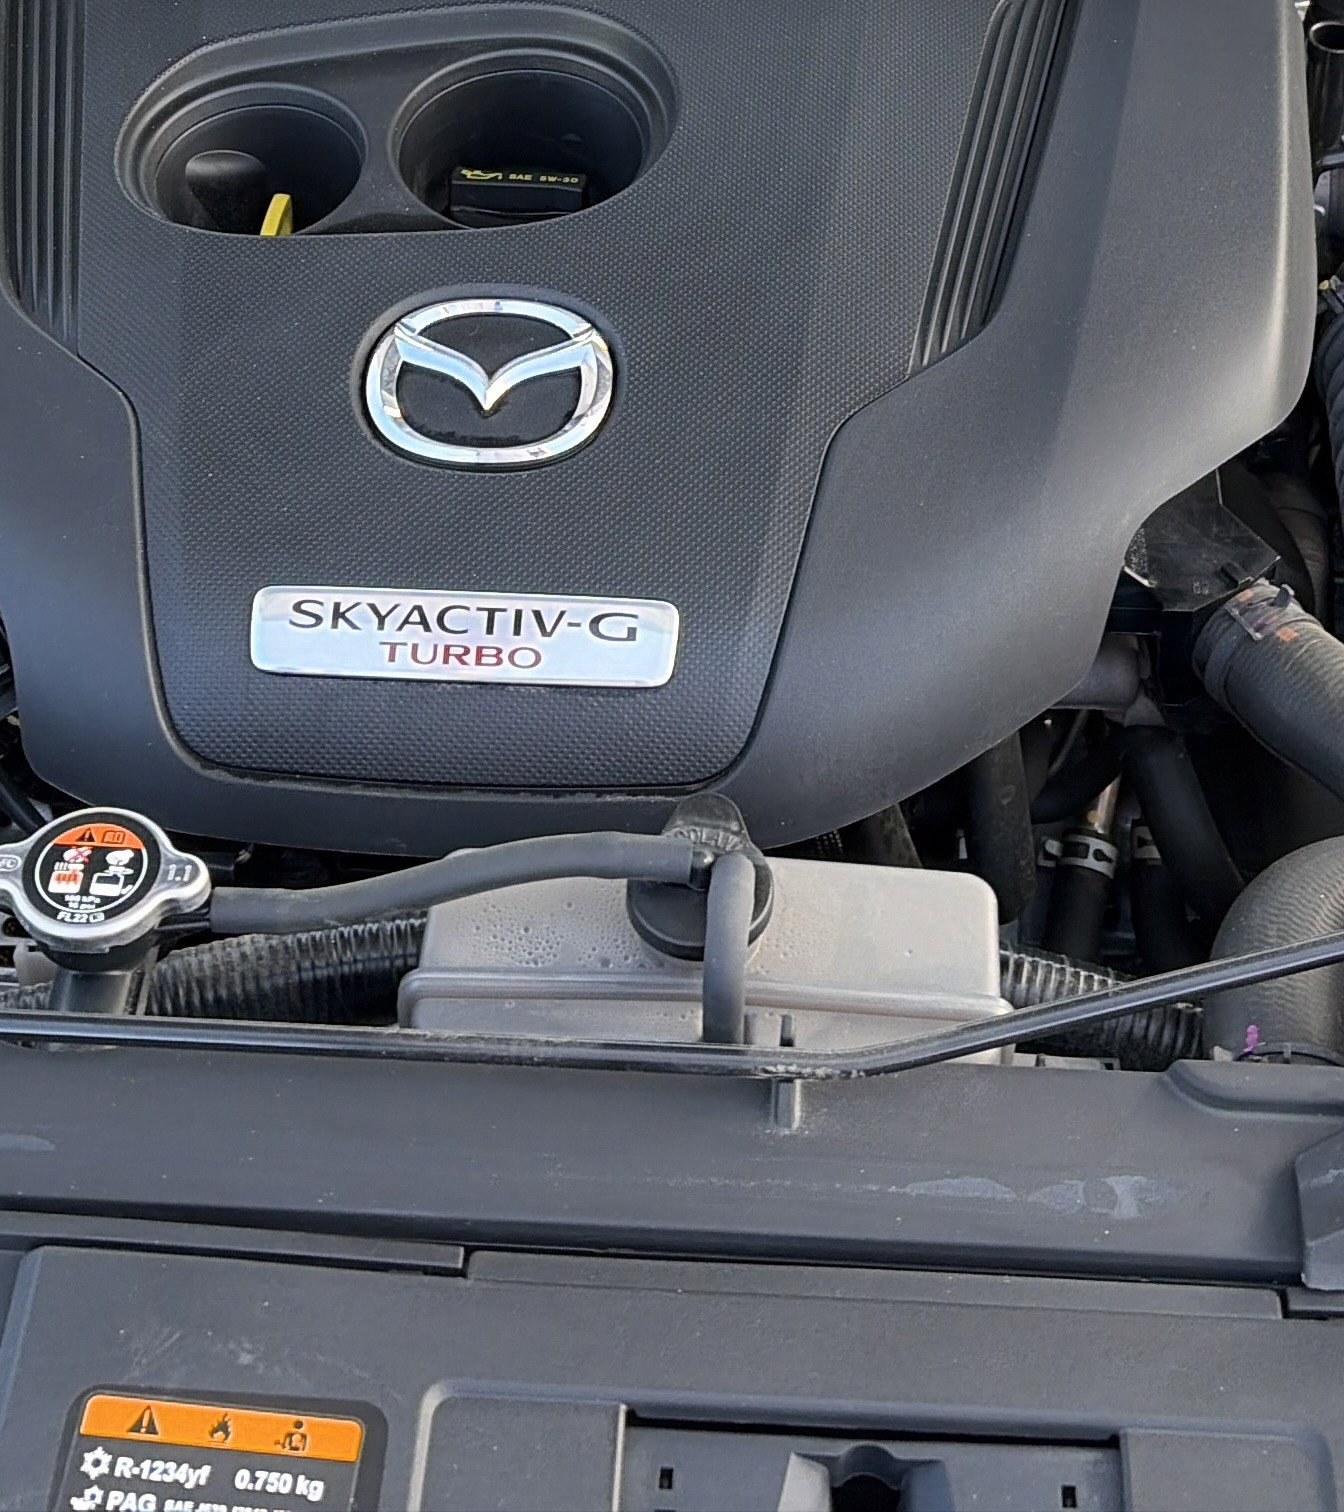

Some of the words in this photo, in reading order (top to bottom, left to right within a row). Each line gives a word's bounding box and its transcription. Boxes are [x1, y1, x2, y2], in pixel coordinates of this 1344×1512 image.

[508, 173, 533, 181] SAE
[539, 175, 579, 184] 5W-30
[288, 598, 640, 643] SKYACTIV-G
[379, 641, 542, 670] TURBO
[166, 862, 194, 882] 1.1
[114, 1456, 211, 1489] R-1234yf
[234, 1468, 293, 1494] 0.750
[295, 1474, 325, 1501] kg
[106, 1490, 157, 1512] PAG
